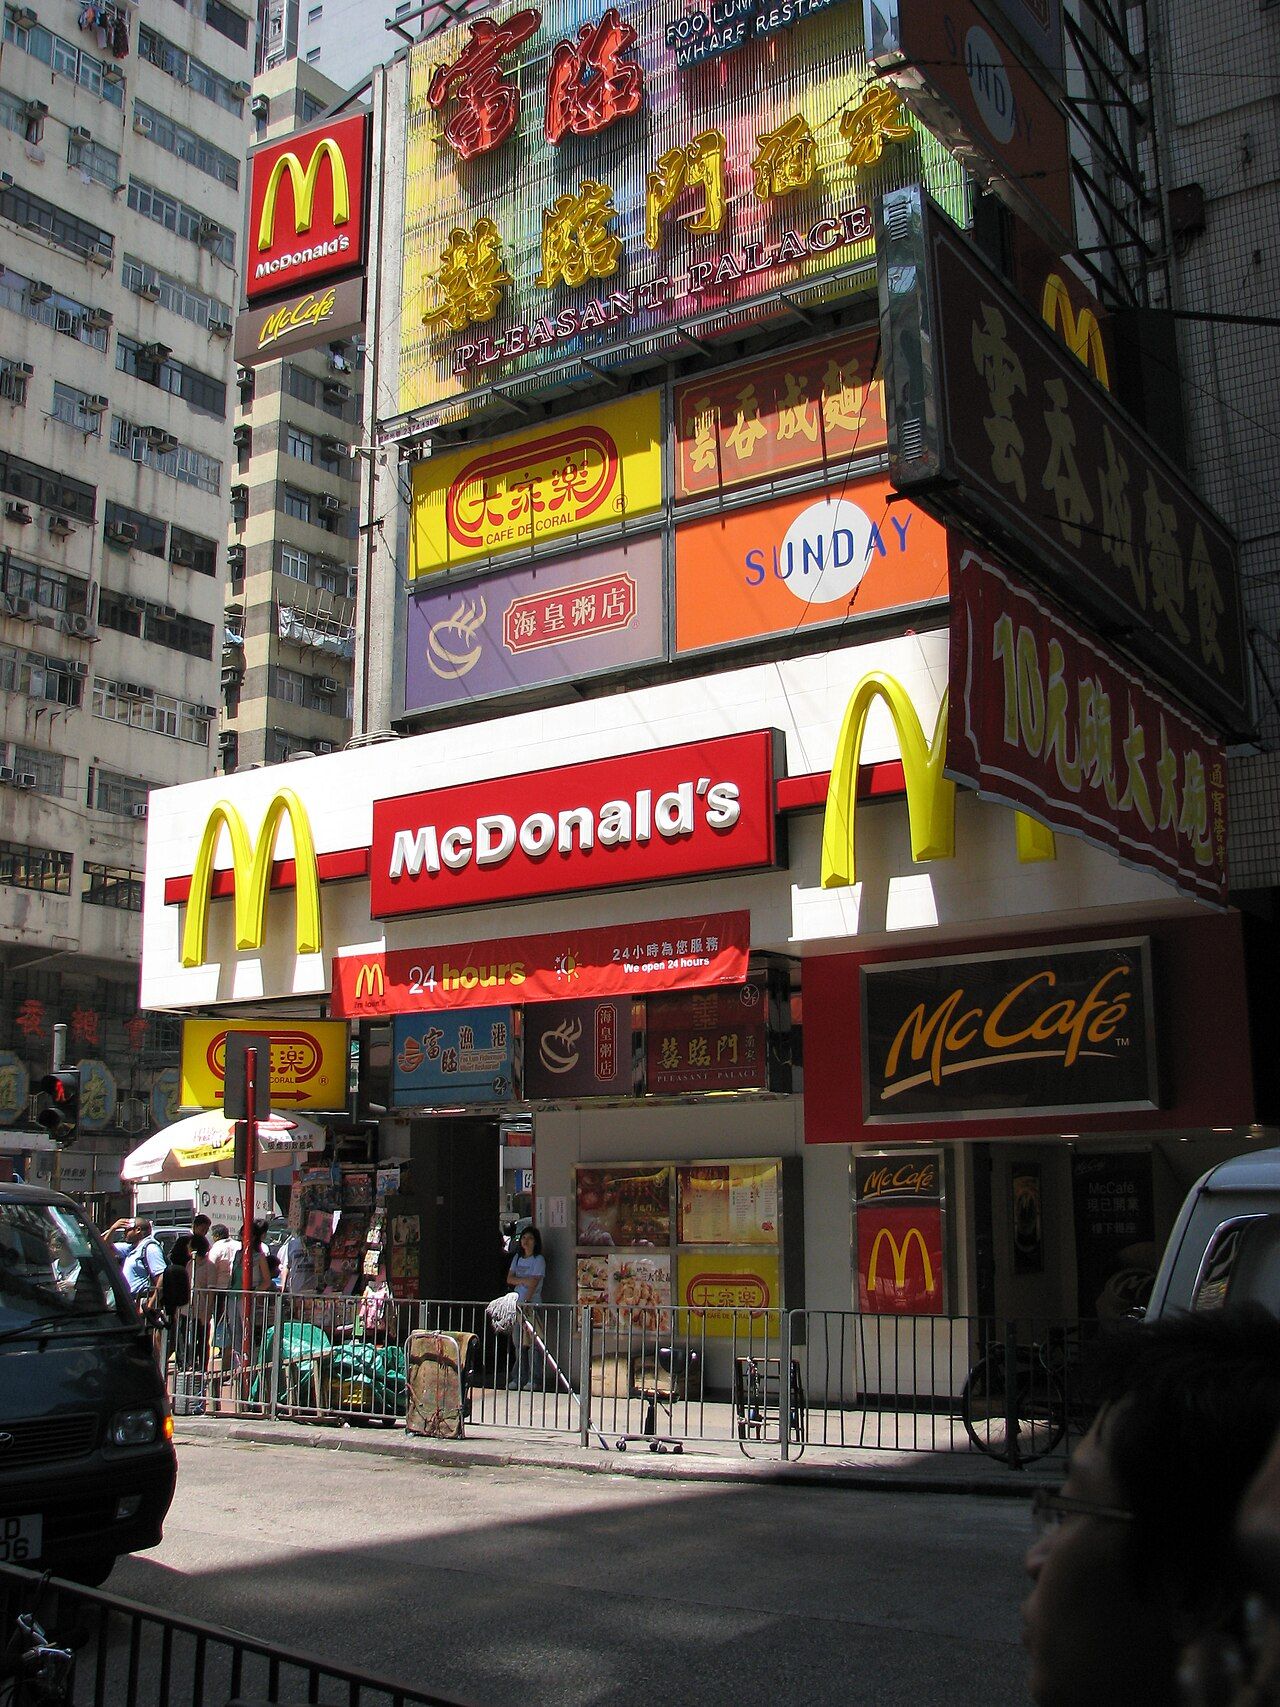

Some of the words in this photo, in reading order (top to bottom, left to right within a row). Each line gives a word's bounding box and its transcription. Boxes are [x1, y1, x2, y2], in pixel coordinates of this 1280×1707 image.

[666, 12, 705, 43] FOO
[676, 23, 745, 66] WHARF
[254, 233, 350, 279] McDonald's
[453, 275, 669, 375] PLEASANT
[690, 206, 873, 293] PALACE
[259, 288, 337, 344] McCafé
[486, 525, 514, 545] CAFÉ
[517, 522, 533, 536] DE
[535, 513, 575, 532] CORAL
[745, 514, 913, 586] SUNDAY
[513, 586, 626, 640] 海皇粥店
[388, 777, 741, 878] McDonald's
[612, 937, 719, 961] 24小時為您服務
[623, 963, 640, 974] We
[641, 960, 665, 973] open
[668, 959, 679, 969] 24
[680, 957, 710, 968] hours
[408, 965, 438, 994] 24
[442, 962, 526, 991] hours
[598, 1009, 612, 1076] 海皇粥店
[884, 966, 1130, 1086] McCafé
[270, 1076, 295, 1084] CORAL
[657, 1073, 708, 1083] PLEASANT
[717, 1069, 756, 1079] PALACE
[864, 1163, 936, 1197] McCafé
